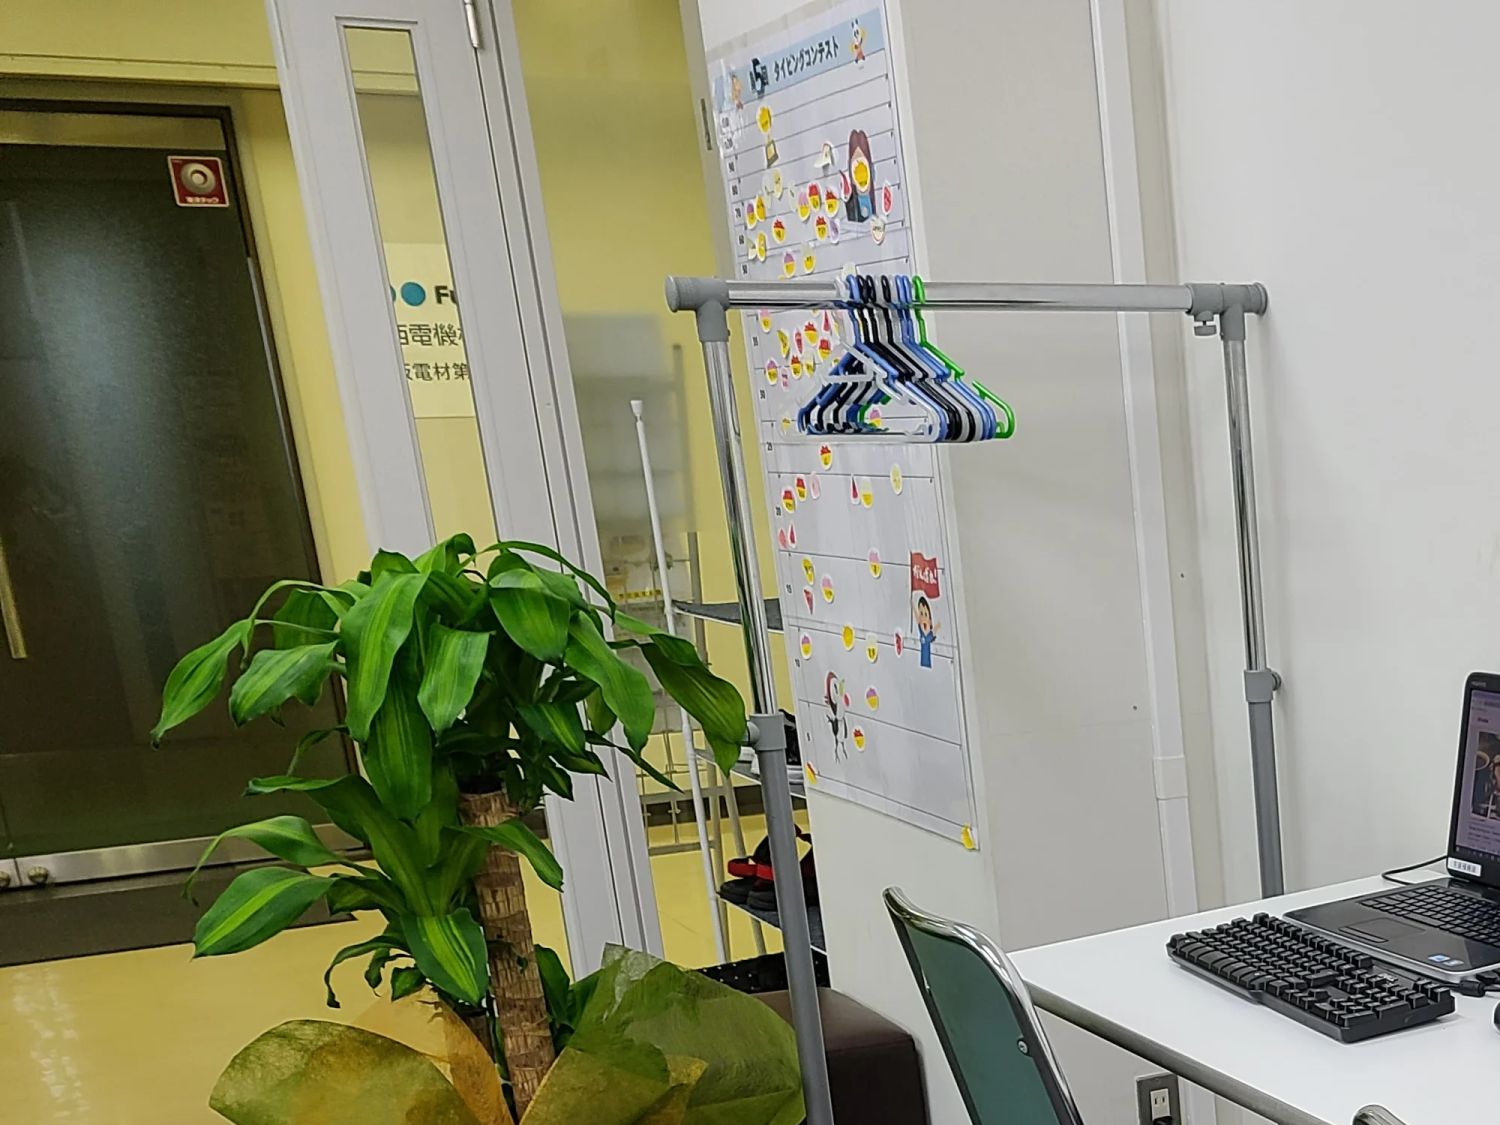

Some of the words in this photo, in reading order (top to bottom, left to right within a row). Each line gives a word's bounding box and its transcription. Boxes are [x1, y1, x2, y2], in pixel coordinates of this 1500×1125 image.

[774, 35, 839, 82] タイピングコンテスト
[397, 323, 465, 347] 電機
